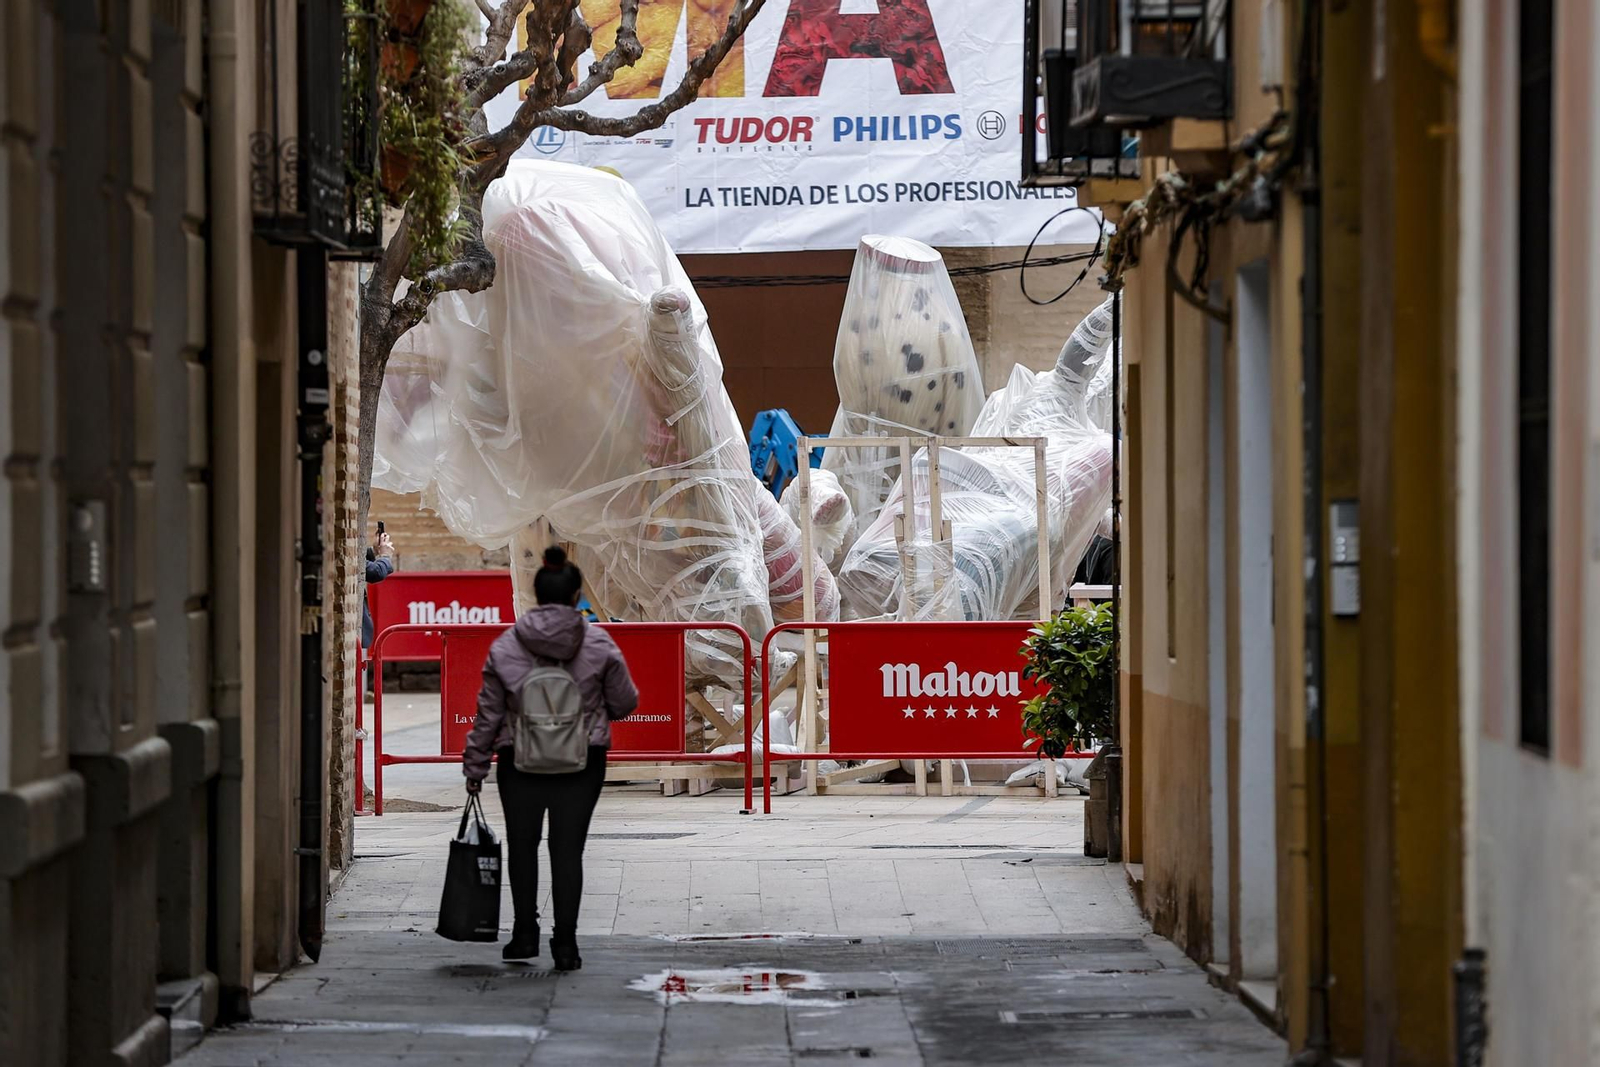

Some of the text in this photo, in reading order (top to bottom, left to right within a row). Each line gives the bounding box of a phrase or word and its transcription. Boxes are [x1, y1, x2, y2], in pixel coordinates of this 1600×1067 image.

[694, 116, 814, 144] TUDOR
[833, 114, 962, 142] PHILIPS
[685, 180, 1076, 207] LA TIENDA DE LOS PROFESIONALES
[407, 599, 502, 624] Mahou
[879, 661, 1022, 698] Mahou
[454, 713, 468, 724] La
